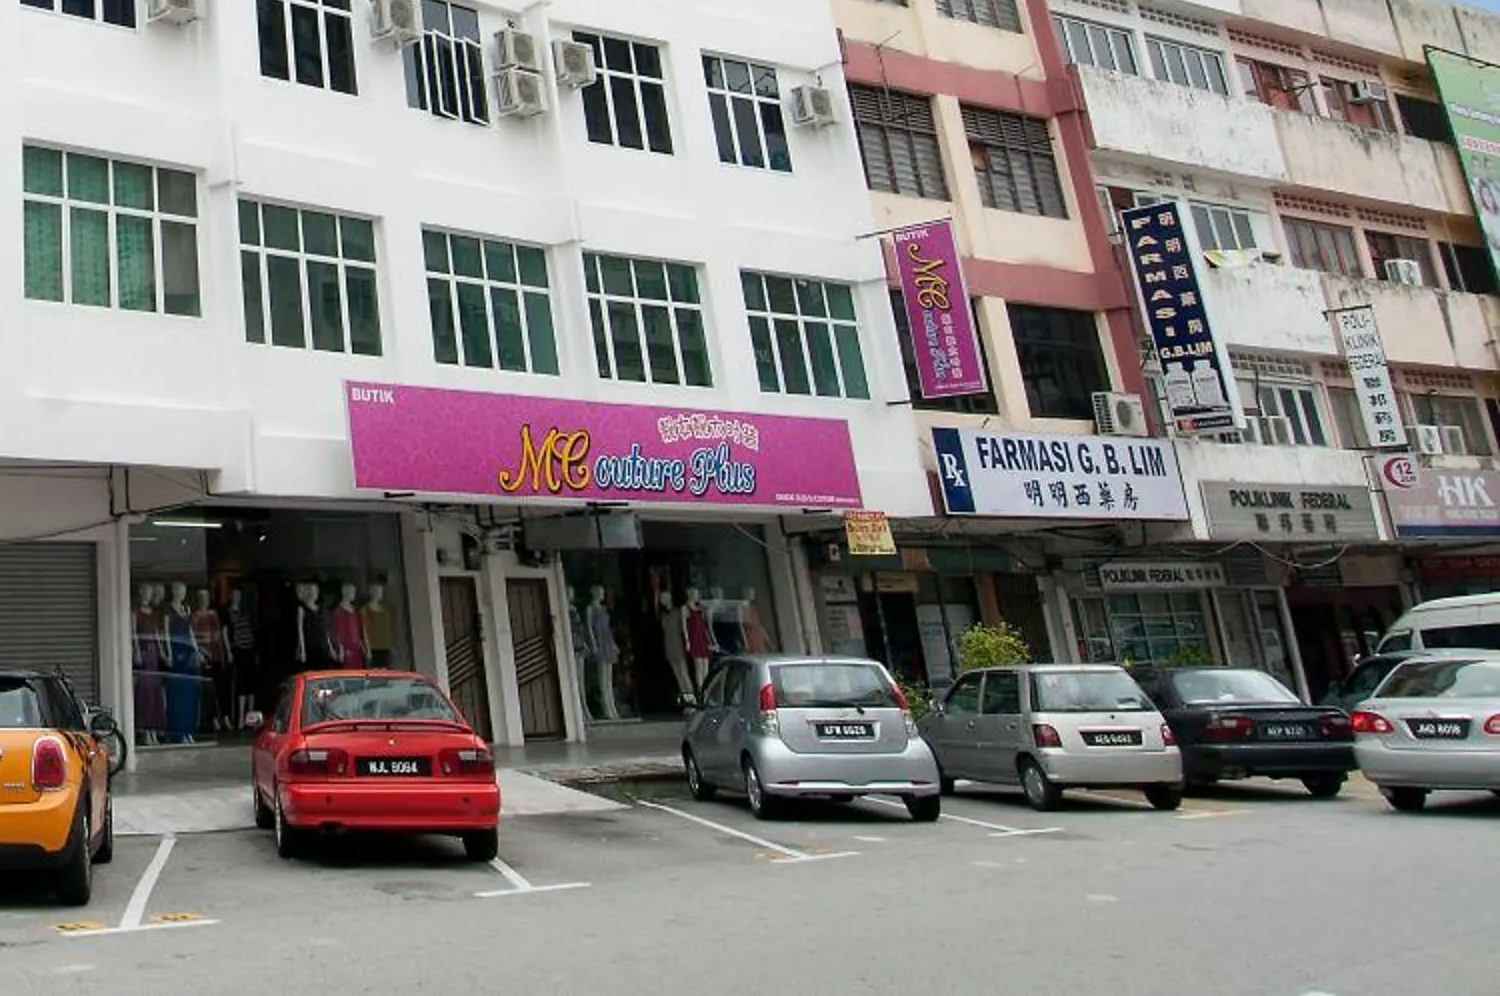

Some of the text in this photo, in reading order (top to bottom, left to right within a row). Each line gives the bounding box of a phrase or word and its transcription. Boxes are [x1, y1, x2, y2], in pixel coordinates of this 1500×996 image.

[895, 229, 930, 242] BUTIK
[1349, 353, 1388, 370] FEDERAL
[352, 388, 395, 404] BUTIK
[976, 436, 1074, 473] FARMASI
[1129, 446, 1167, 477] LIM
[689, 442, 757, 496] Plus
[1396, 461, 1413, 475] 12
[1229, 490, 1352, 510] POLIKLINIK FEDERAL
